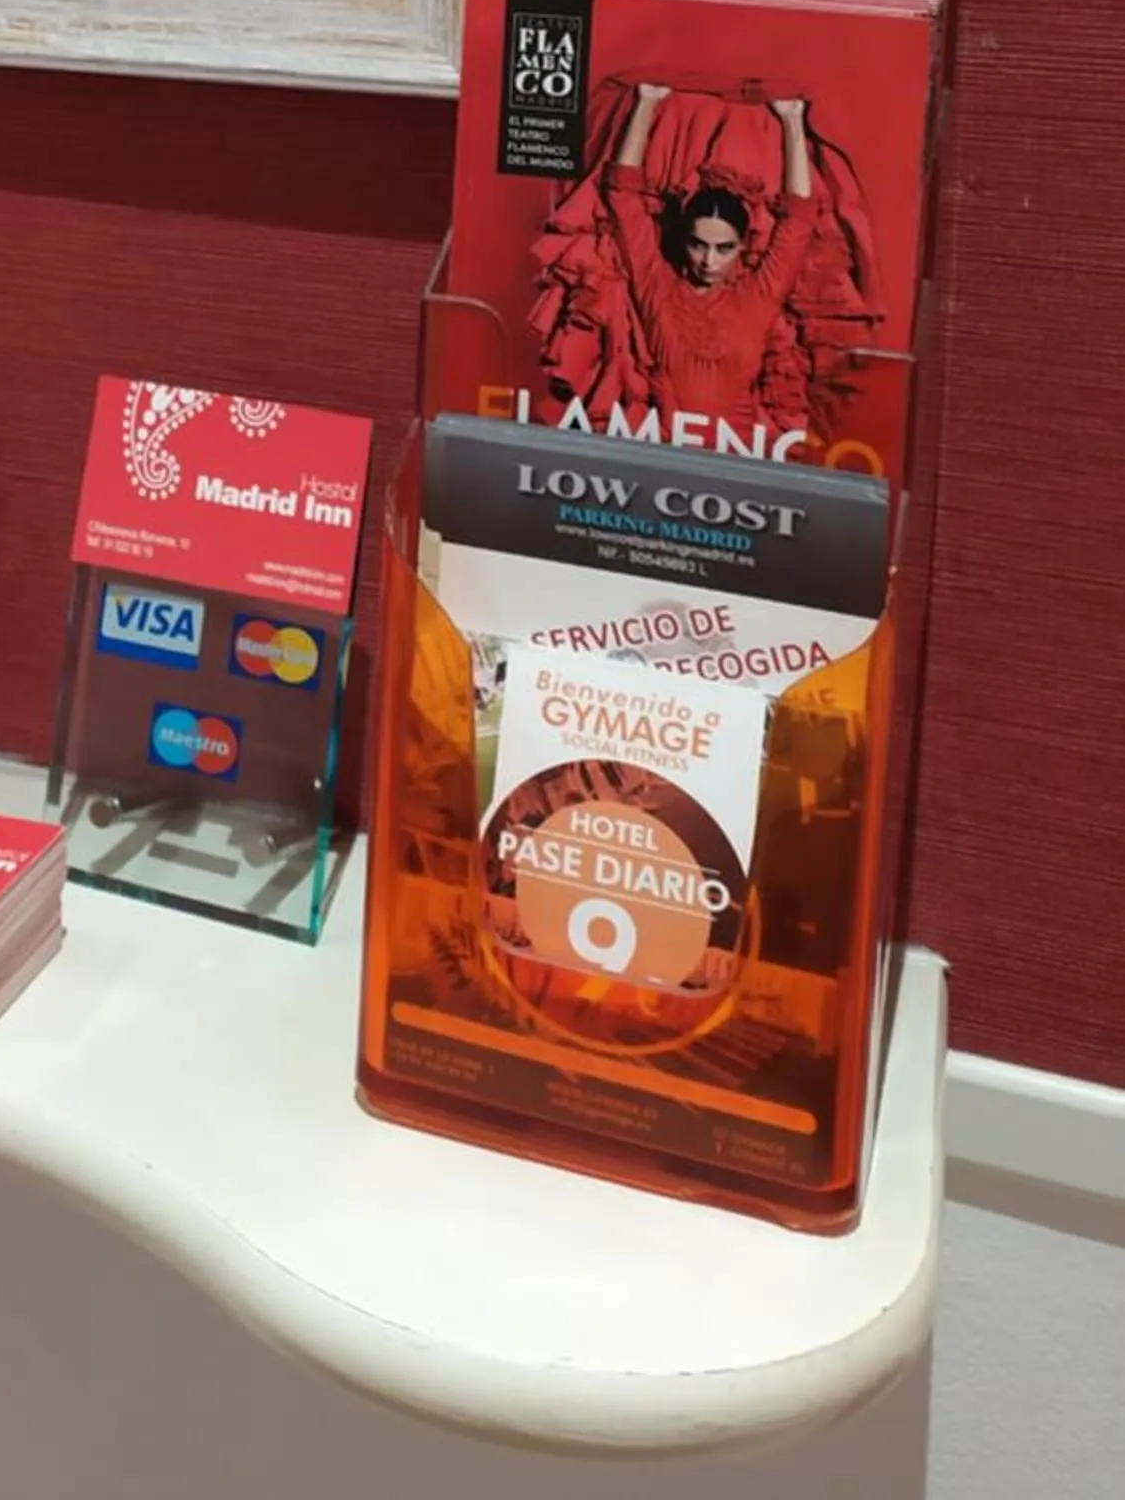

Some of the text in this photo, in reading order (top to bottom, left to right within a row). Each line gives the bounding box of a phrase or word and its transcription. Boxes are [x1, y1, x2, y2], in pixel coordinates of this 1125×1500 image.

[518, 27, 575, 55] FLA
[514, 69, 574, 98] CO
[507, 141, 570, 158] FLAMENCO
[508, 128, 551, 142] TEATRO
[506, 154, 575, 171] DEL MUNDO
[194, 474, 353, 528] Madrid Inn
[299, 472, 358, 503] Hostal
[516, 463, 806, 538] LOW COST
[558, 503, 754, 551] PARKING MADRID
[113, 596, 196, 644] VISA
[689, 604, 737, 637] DE
[535, 669, 721, 728] Bienvenido a
[540, 695, 713, 760] GYMAGE
[560, 730, 691, 772] SOCIAL FITNESS
[570, 810, 660, 852] HOTEL
[498, 830, 732, 913] PASE DIARIO
